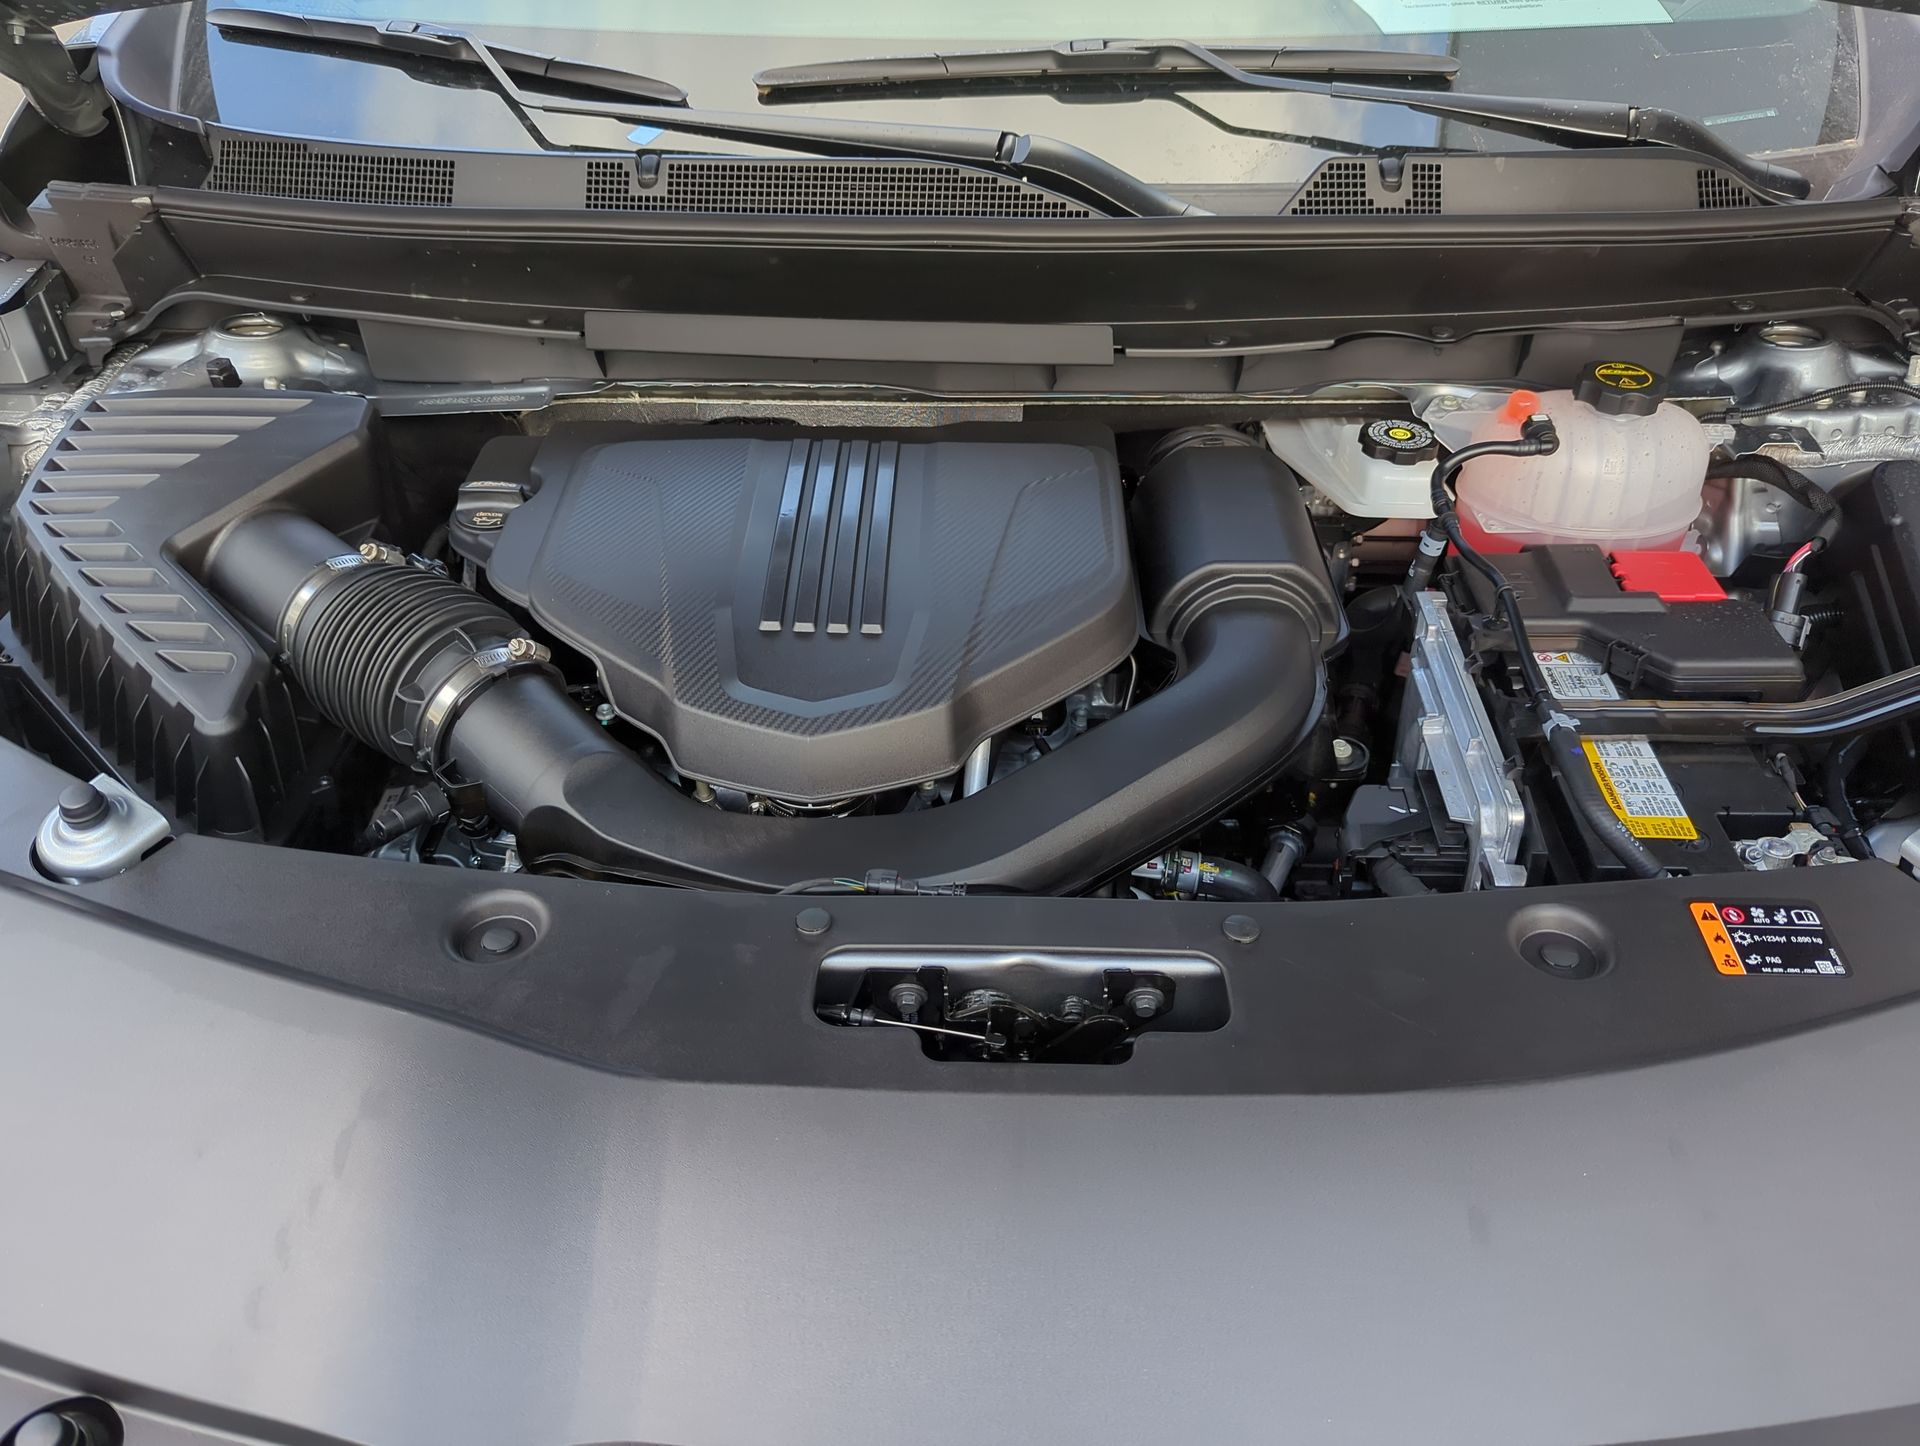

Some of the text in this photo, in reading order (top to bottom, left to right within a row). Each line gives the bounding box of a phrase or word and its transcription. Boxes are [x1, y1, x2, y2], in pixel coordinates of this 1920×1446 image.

[1545, 666, 1565, 696] ACDelco
[1753, 934, 1787, 944] R-1234yf
[1811, 936, 1823, 945] kg
[1765, 956, 1782, 964] PAG
